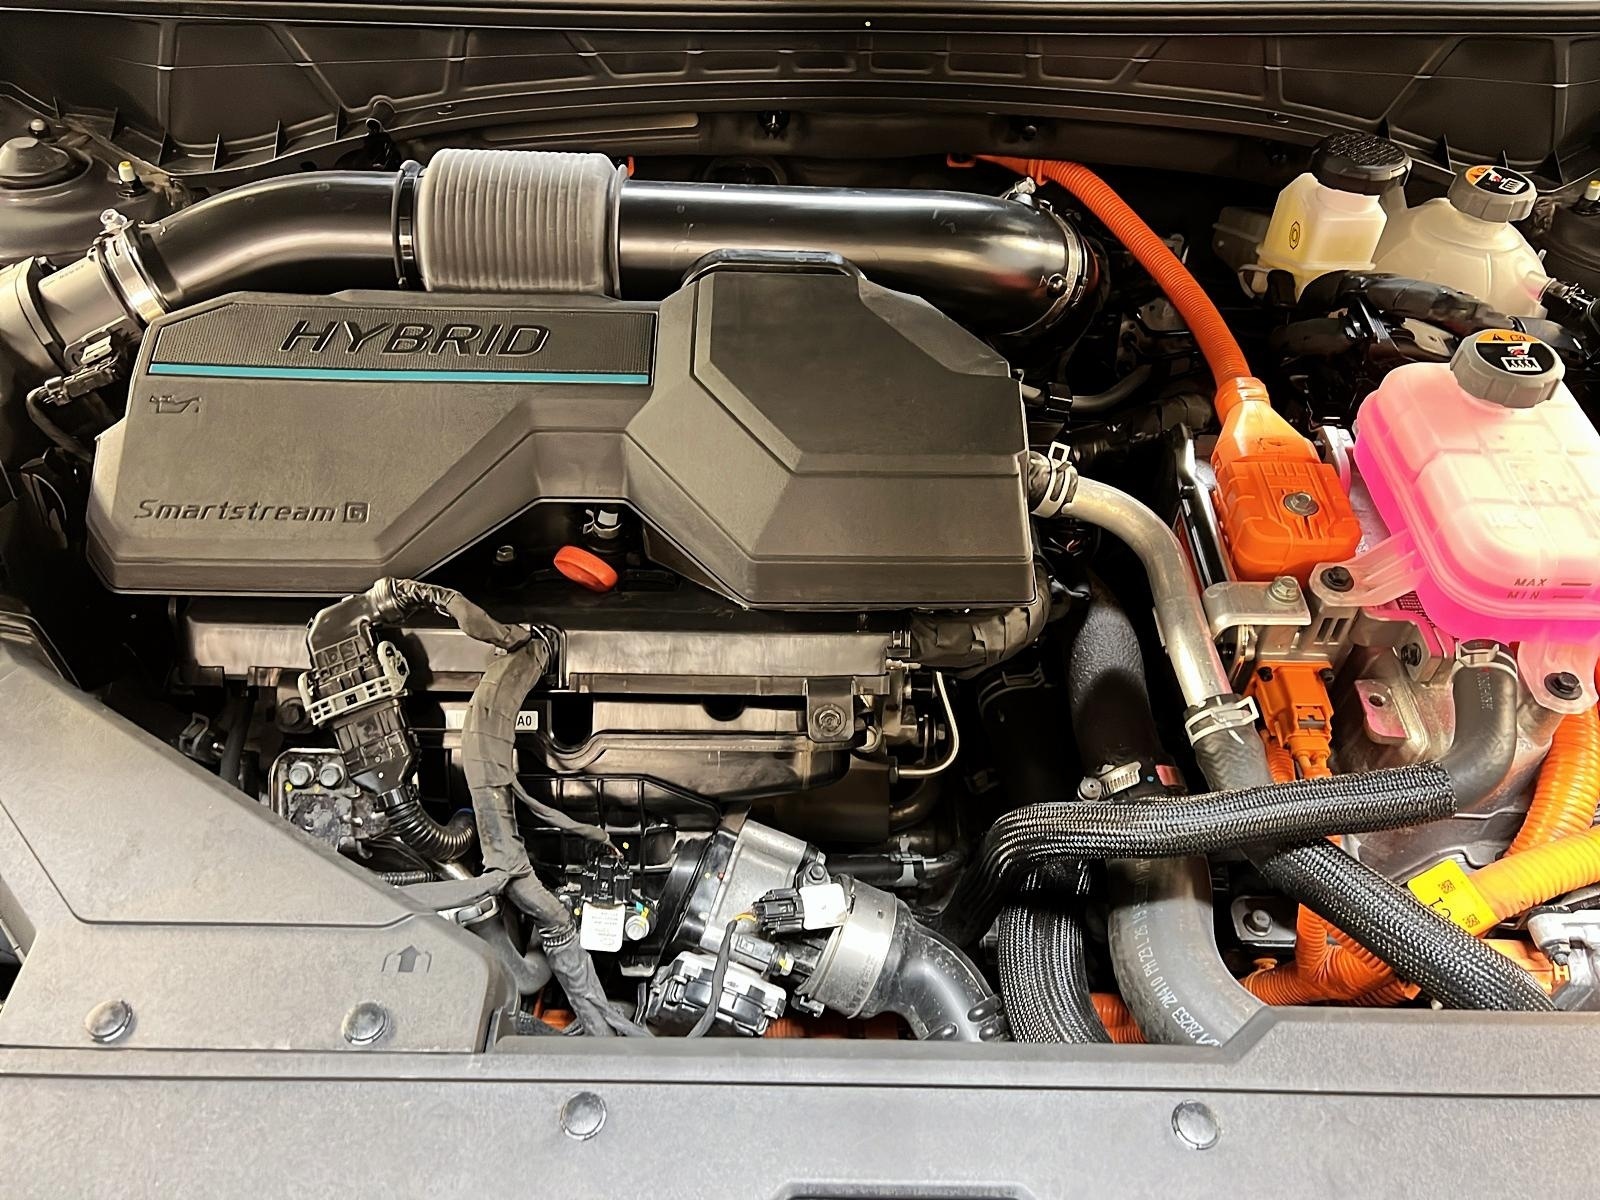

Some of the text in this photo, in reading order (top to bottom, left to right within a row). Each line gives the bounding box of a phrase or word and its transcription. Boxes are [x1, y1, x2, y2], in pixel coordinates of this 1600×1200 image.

[279, 320, 550, 356] HYBRID
[134, 499, 338, 522] Smartstream
[1513, 578, 1547, 587] MAX
[1507, 591, 1540, 600] MIN
[1138, 946, 1153, 962] 23
[1142, 959, 1159, 977] PH
[1171, 1006, 1204, 1039] 28253
